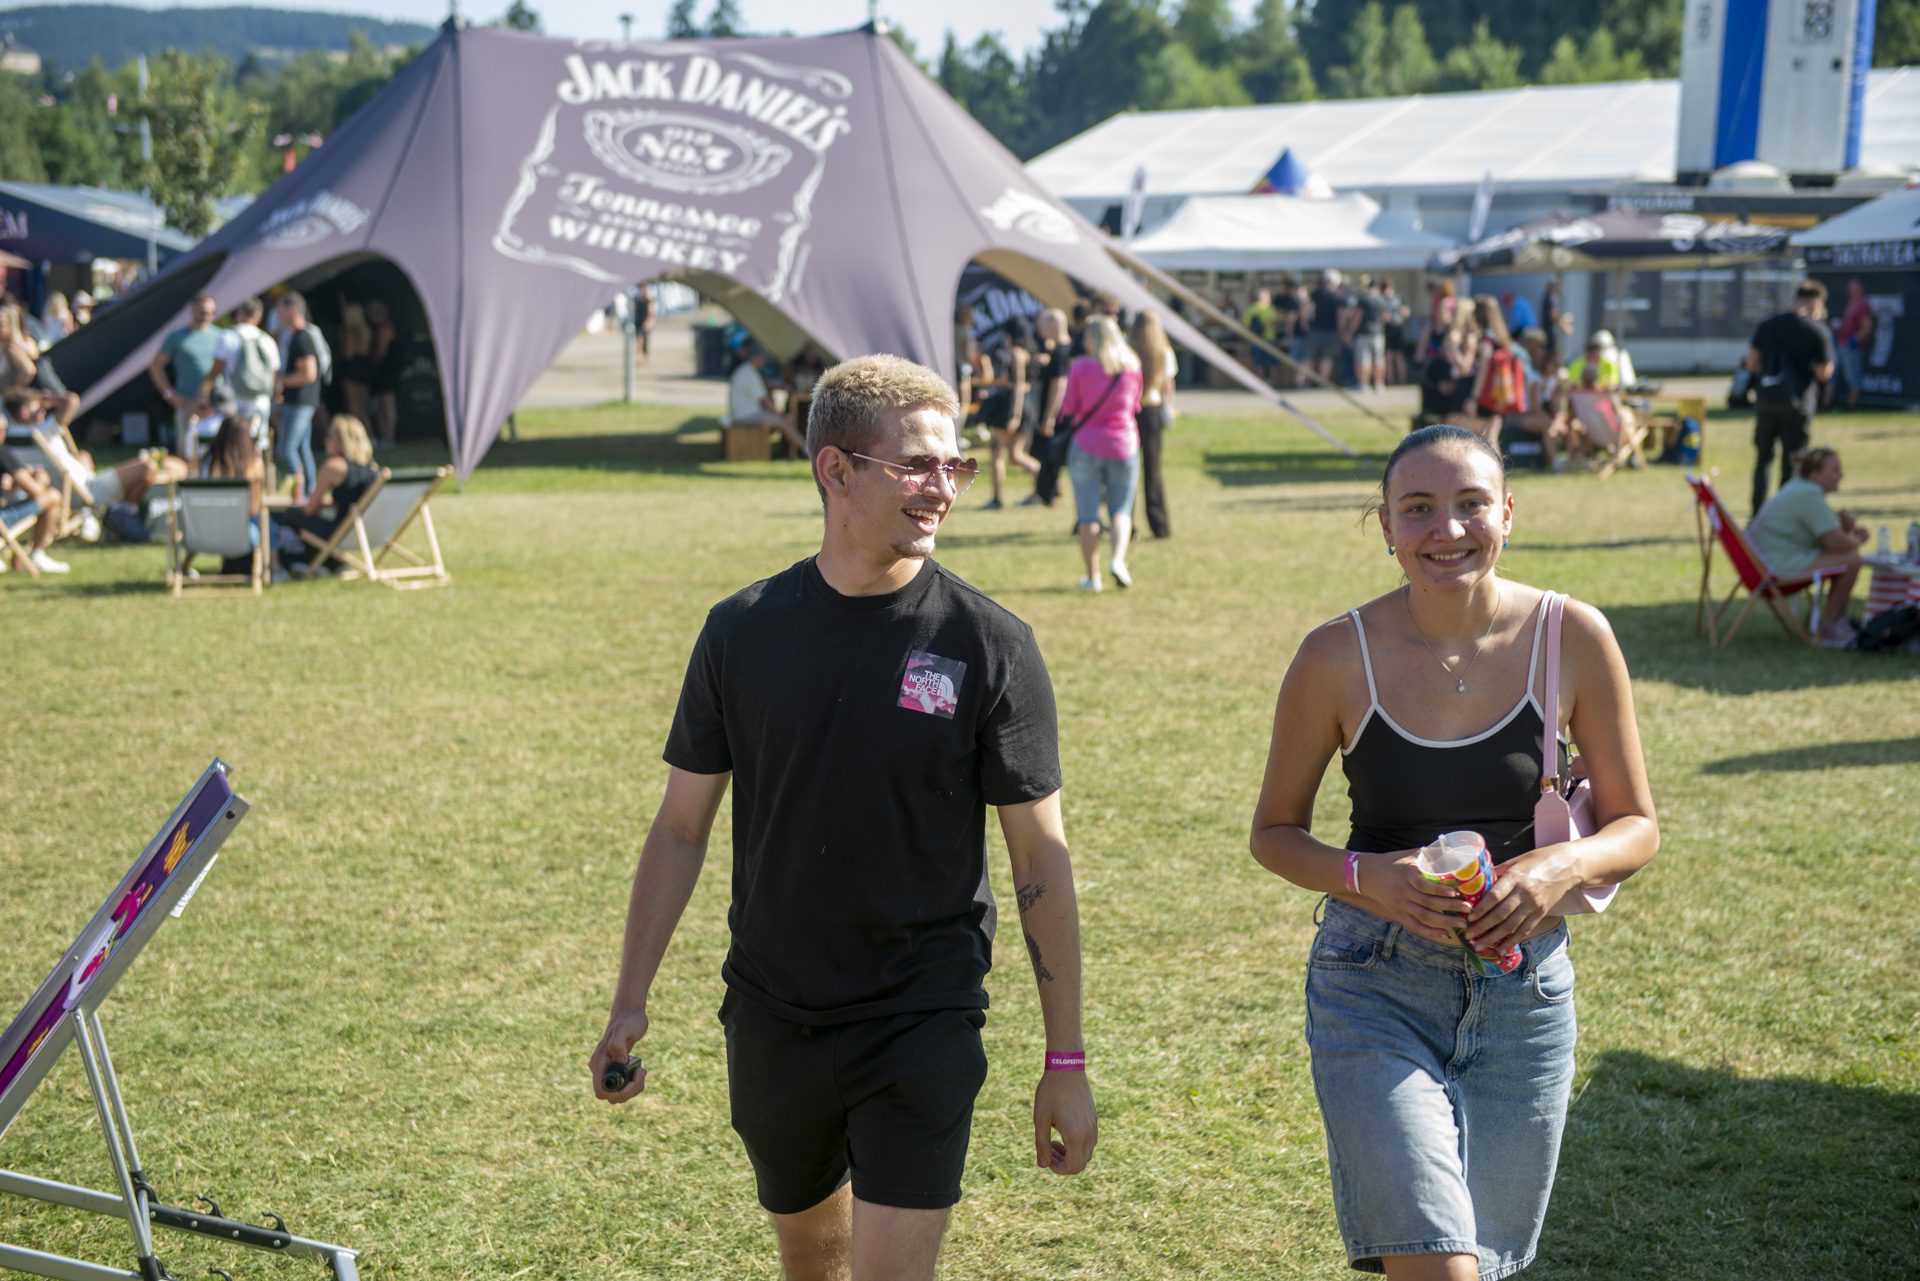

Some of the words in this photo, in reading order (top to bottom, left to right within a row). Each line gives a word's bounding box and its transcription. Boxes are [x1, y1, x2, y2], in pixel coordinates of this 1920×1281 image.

[557, 53, 676, 105] JACK
[679, 54, 852, 151] DANIEL'S
[556, 171, 763, 239] Tennessee
[549, 214, 748, 273] WHISKEY
[908, 673, 940, 689] NORTH
[915, 682, 938, 697] FACE
[924, 669, 941, 681] THE
